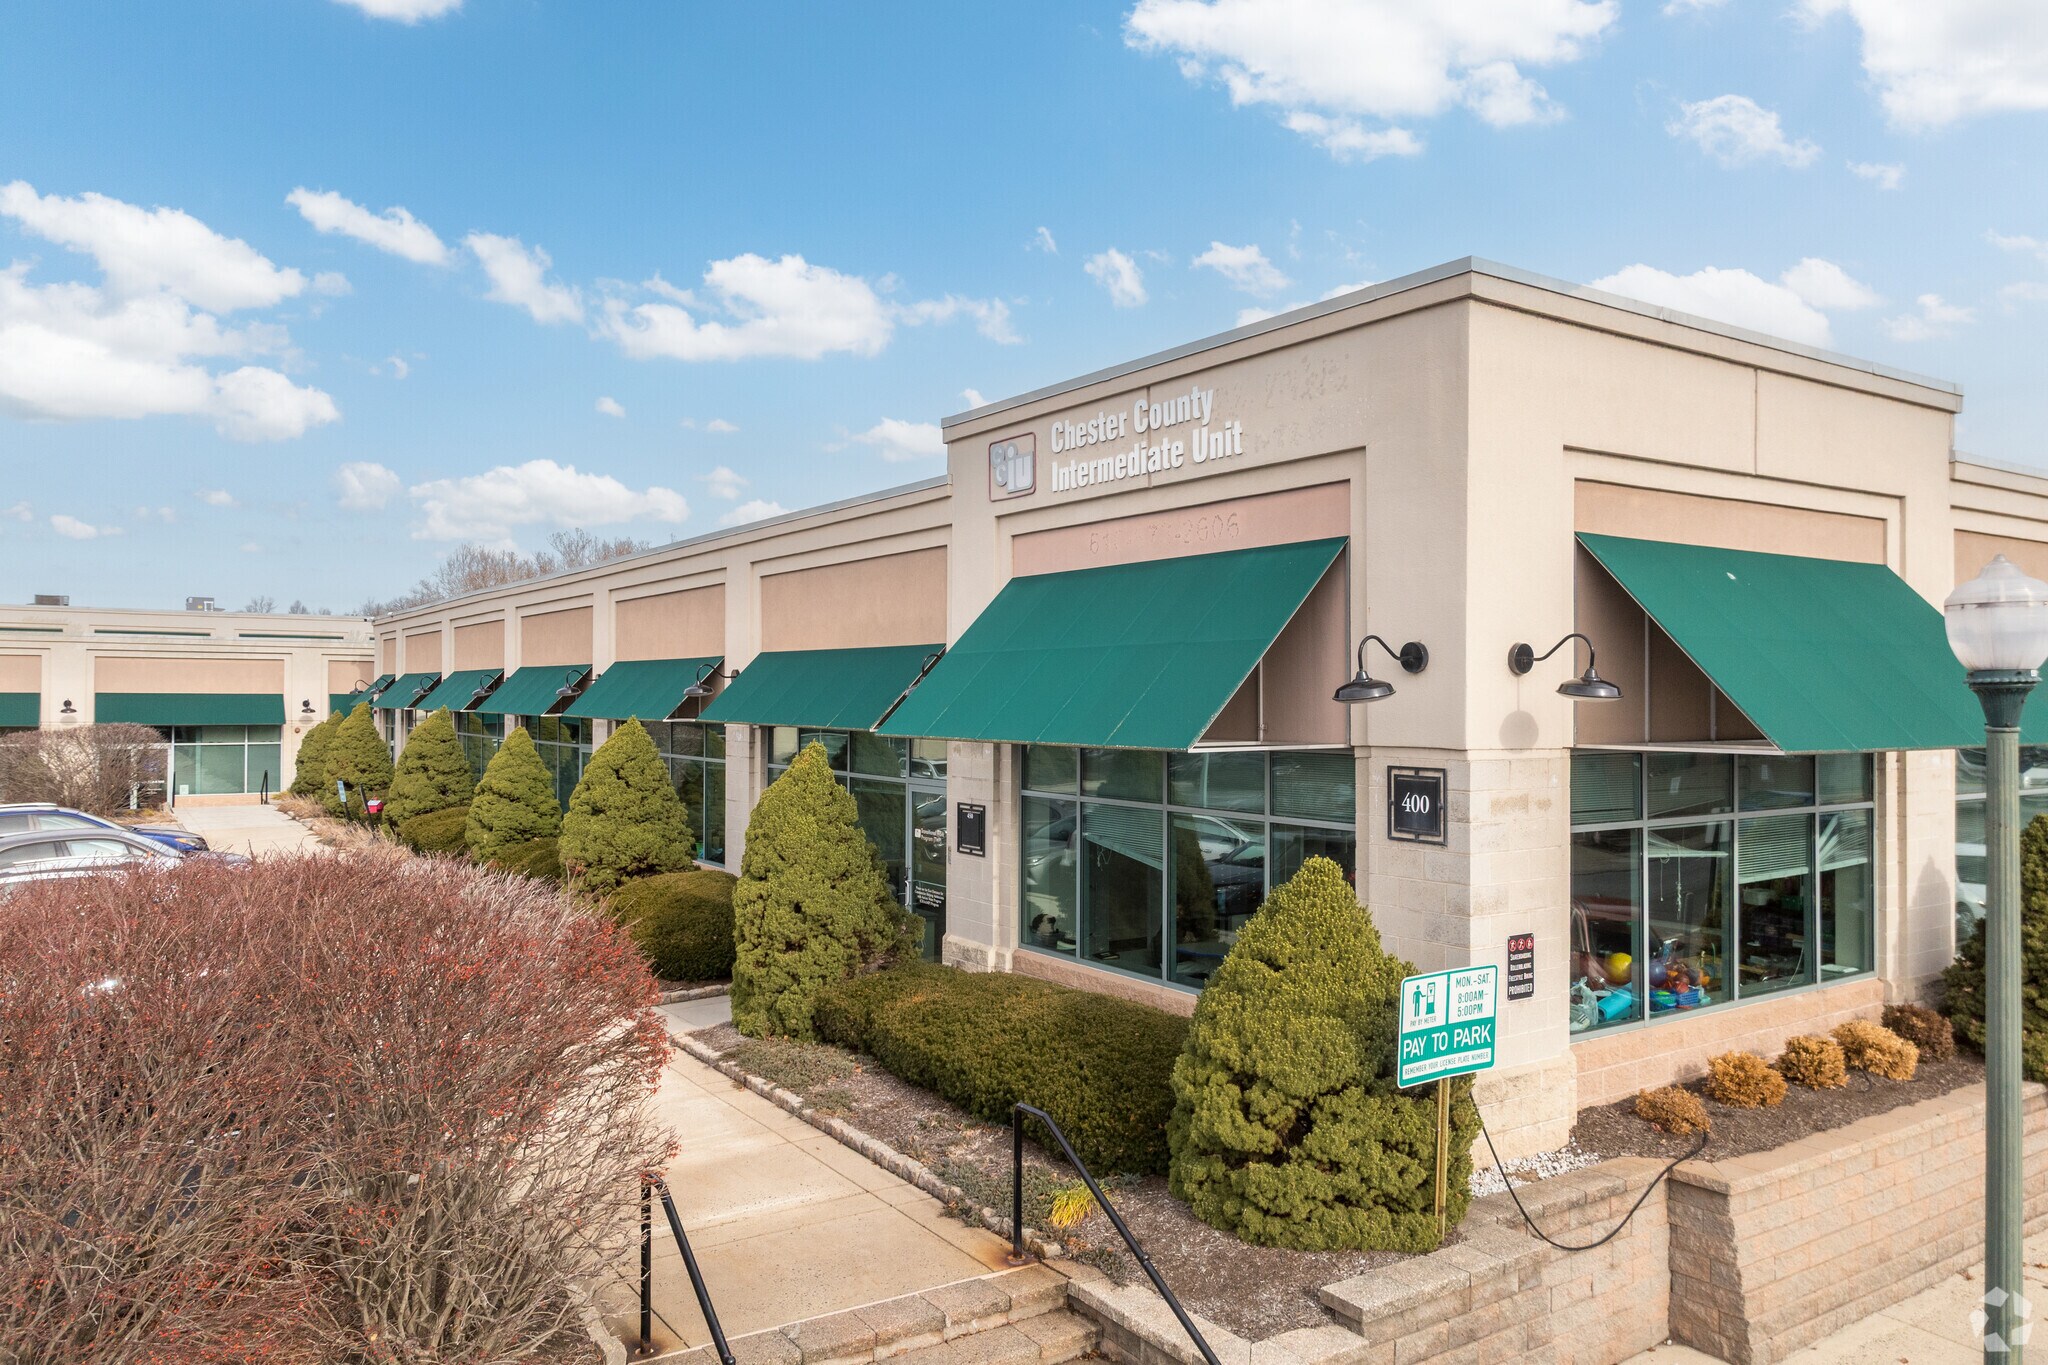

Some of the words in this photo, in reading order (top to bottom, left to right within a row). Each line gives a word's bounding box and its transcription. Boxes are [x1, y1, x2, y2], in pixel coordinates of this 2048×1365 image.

[1051, 411, 1127, 453] Chester
[1134, 386, 1214, 434] County
[1052, 437, 1184, 492] Intermediate
[1192, 420, 1243, 463] Unit
[1402, 792, 1430, 814] 400
[1509, 983, 1532, 995] PROHIBITED
[1424, 1015, 1437, 1023] METER
[1457, 1003, 1483, 1017] 5:00PM
[1403, 1036, 1427, 1060] PAY
[1432, 1032, 1448, 1053] TO
[1453, 1023, 1492, 1049] PARK
[1404, 1064, 1427, 1076] REMEMBER
[1428, 1061, 1438, 1071] YOUR
[1440, 1056, 1456, 1068] LICENSE
[1458, 1054, 1470, 1064] PLATE
[1471, 1051, 1489, 1062] NUMBER
